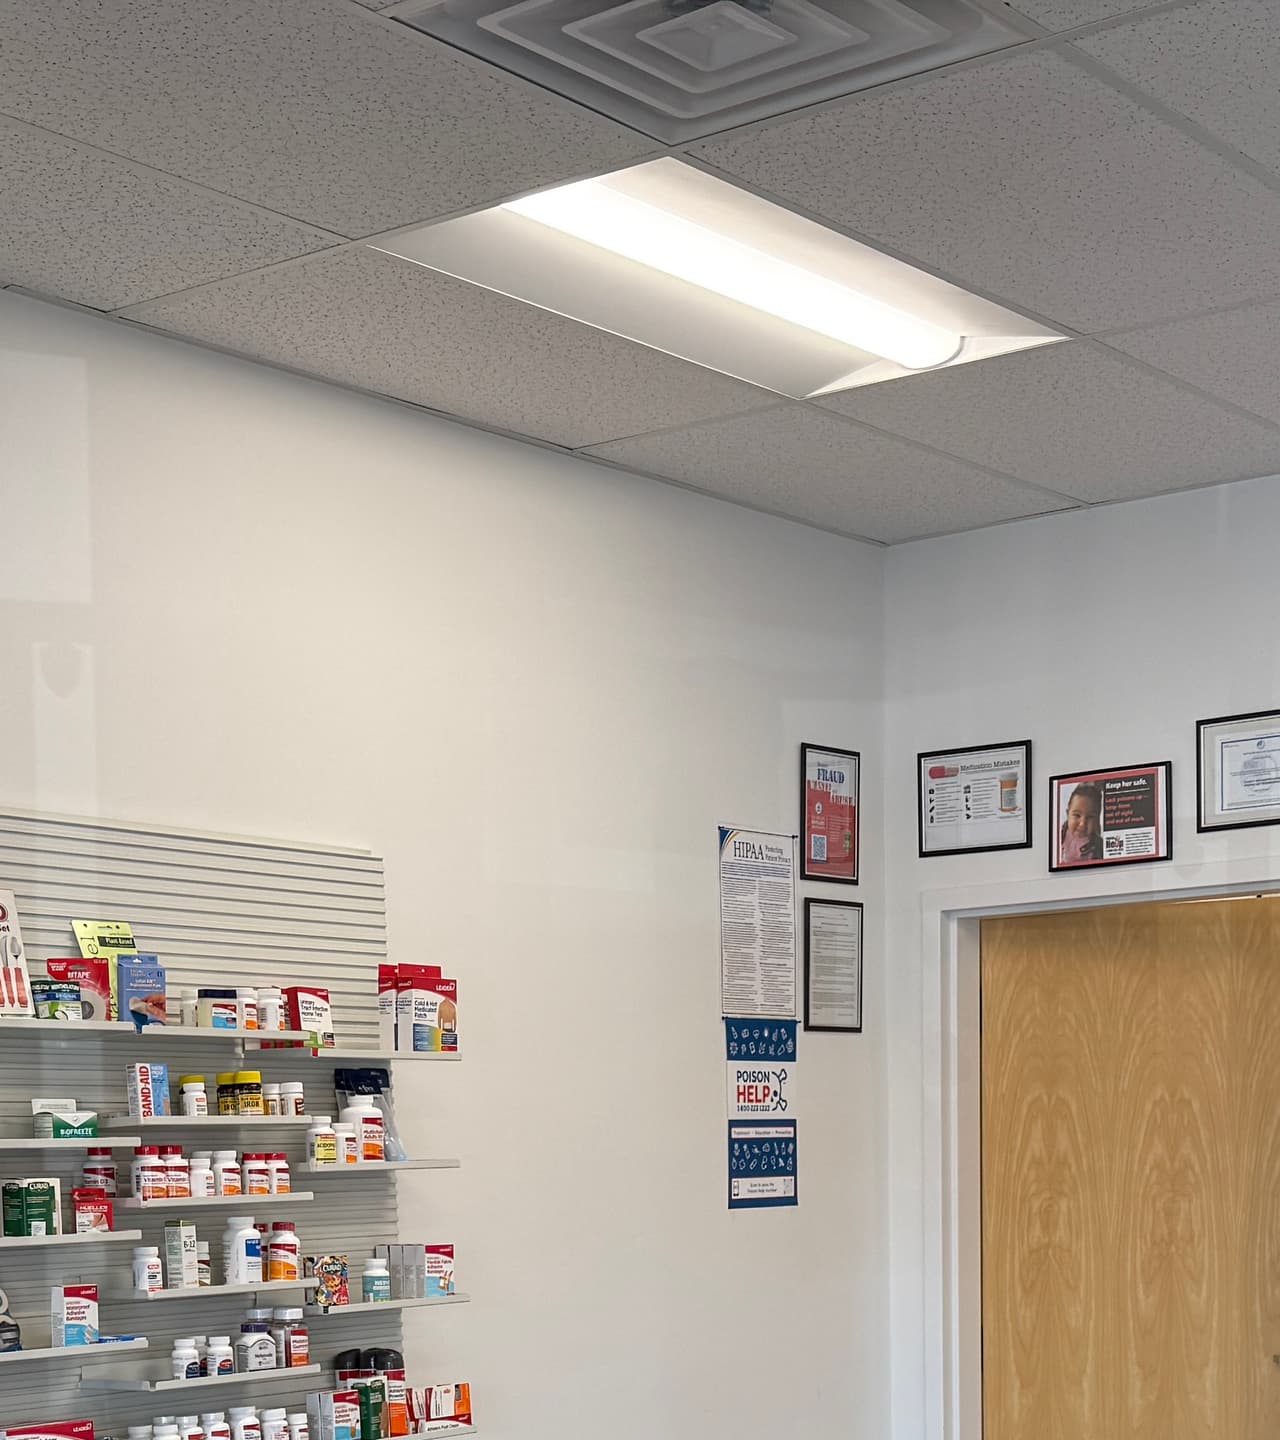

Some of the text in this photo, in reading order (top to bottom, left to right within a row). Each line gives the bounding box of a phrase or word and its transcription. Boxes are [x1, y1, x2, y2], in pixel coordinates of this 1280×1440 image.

[817, 768, 844, 784] FRAUD
[734, 841, 764, 860] HIPAA
[736, 1070, 770, 1083] POISON
[142, 1066, 152, 1118] BAND-AID
[737, 1085, 770, 1103] HELP
[29, 1182, 48, 1190] CURAD
